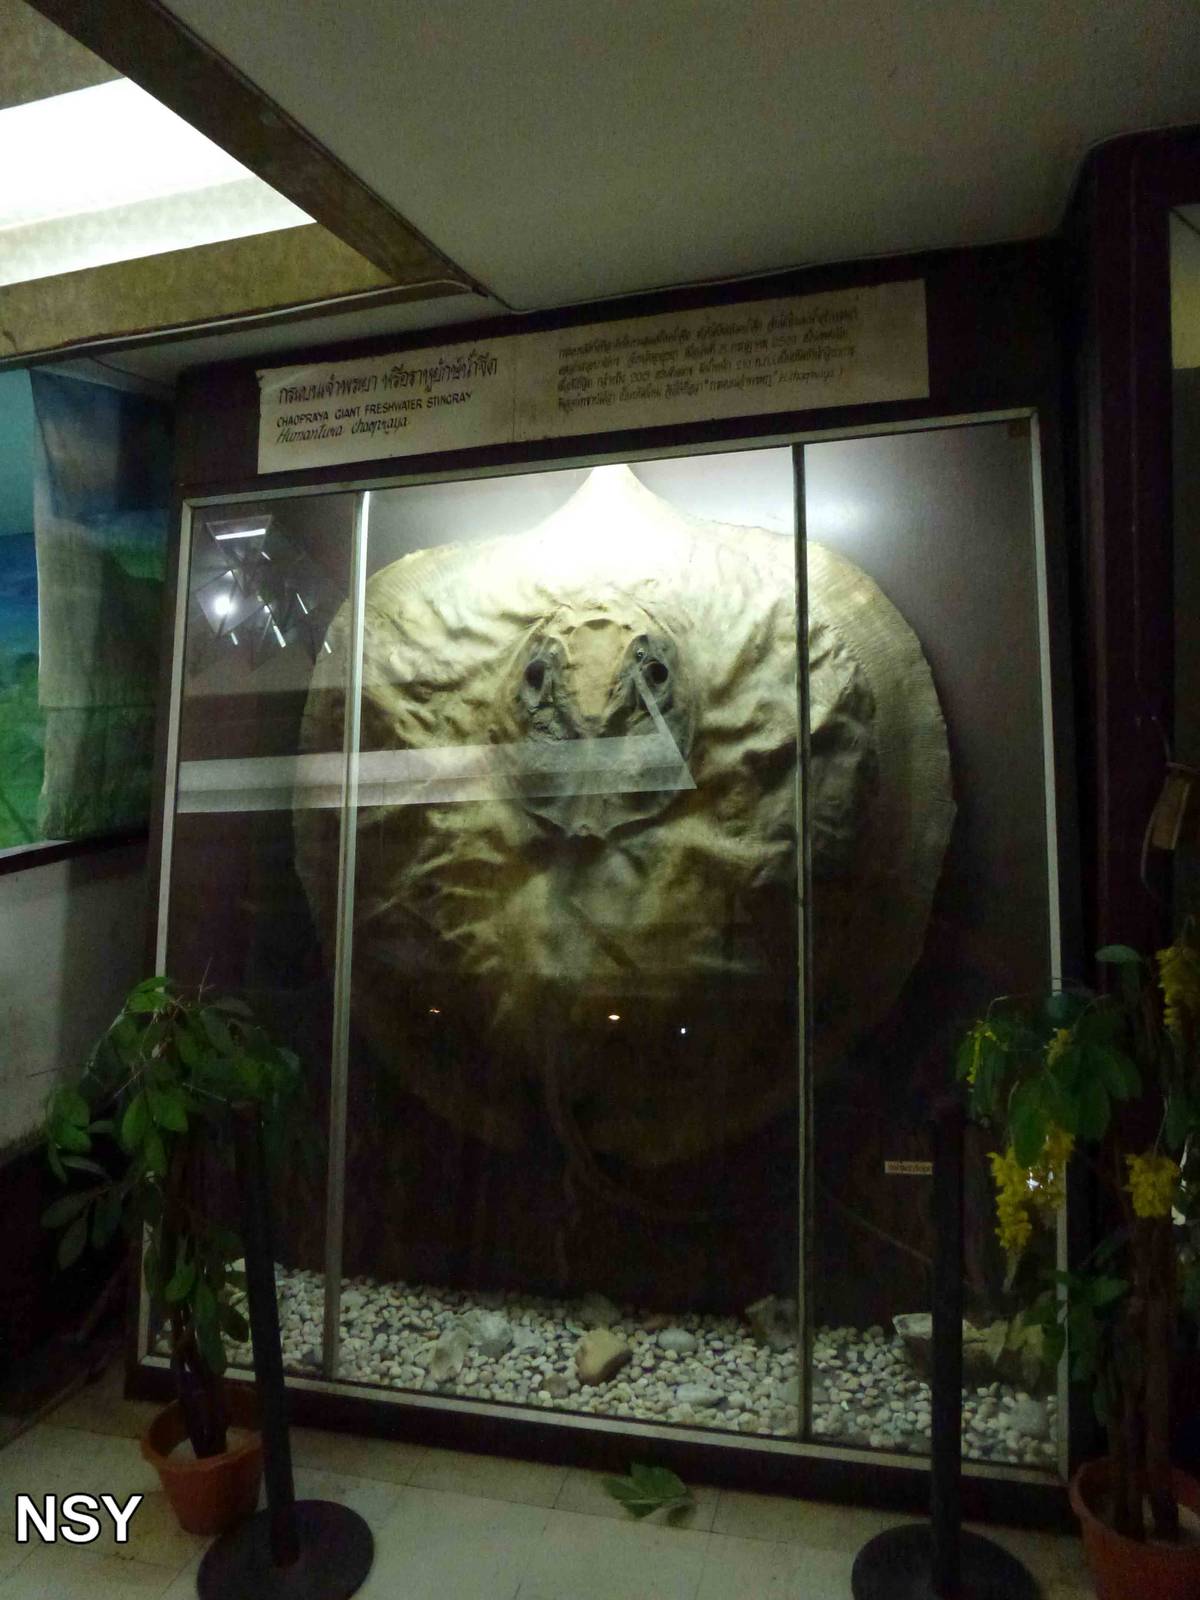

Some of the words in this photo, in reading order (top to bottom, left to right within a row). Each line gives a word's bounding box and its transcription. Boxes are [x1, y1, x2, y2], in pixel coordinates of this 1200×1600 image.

[276, 411, 329, 428] CHAOPRAYA
[335, 406, 361, 420] GIANT
[365, 398, 422, 415] FRESHWATER
[426, 391, 472, 408] STINGRAY
